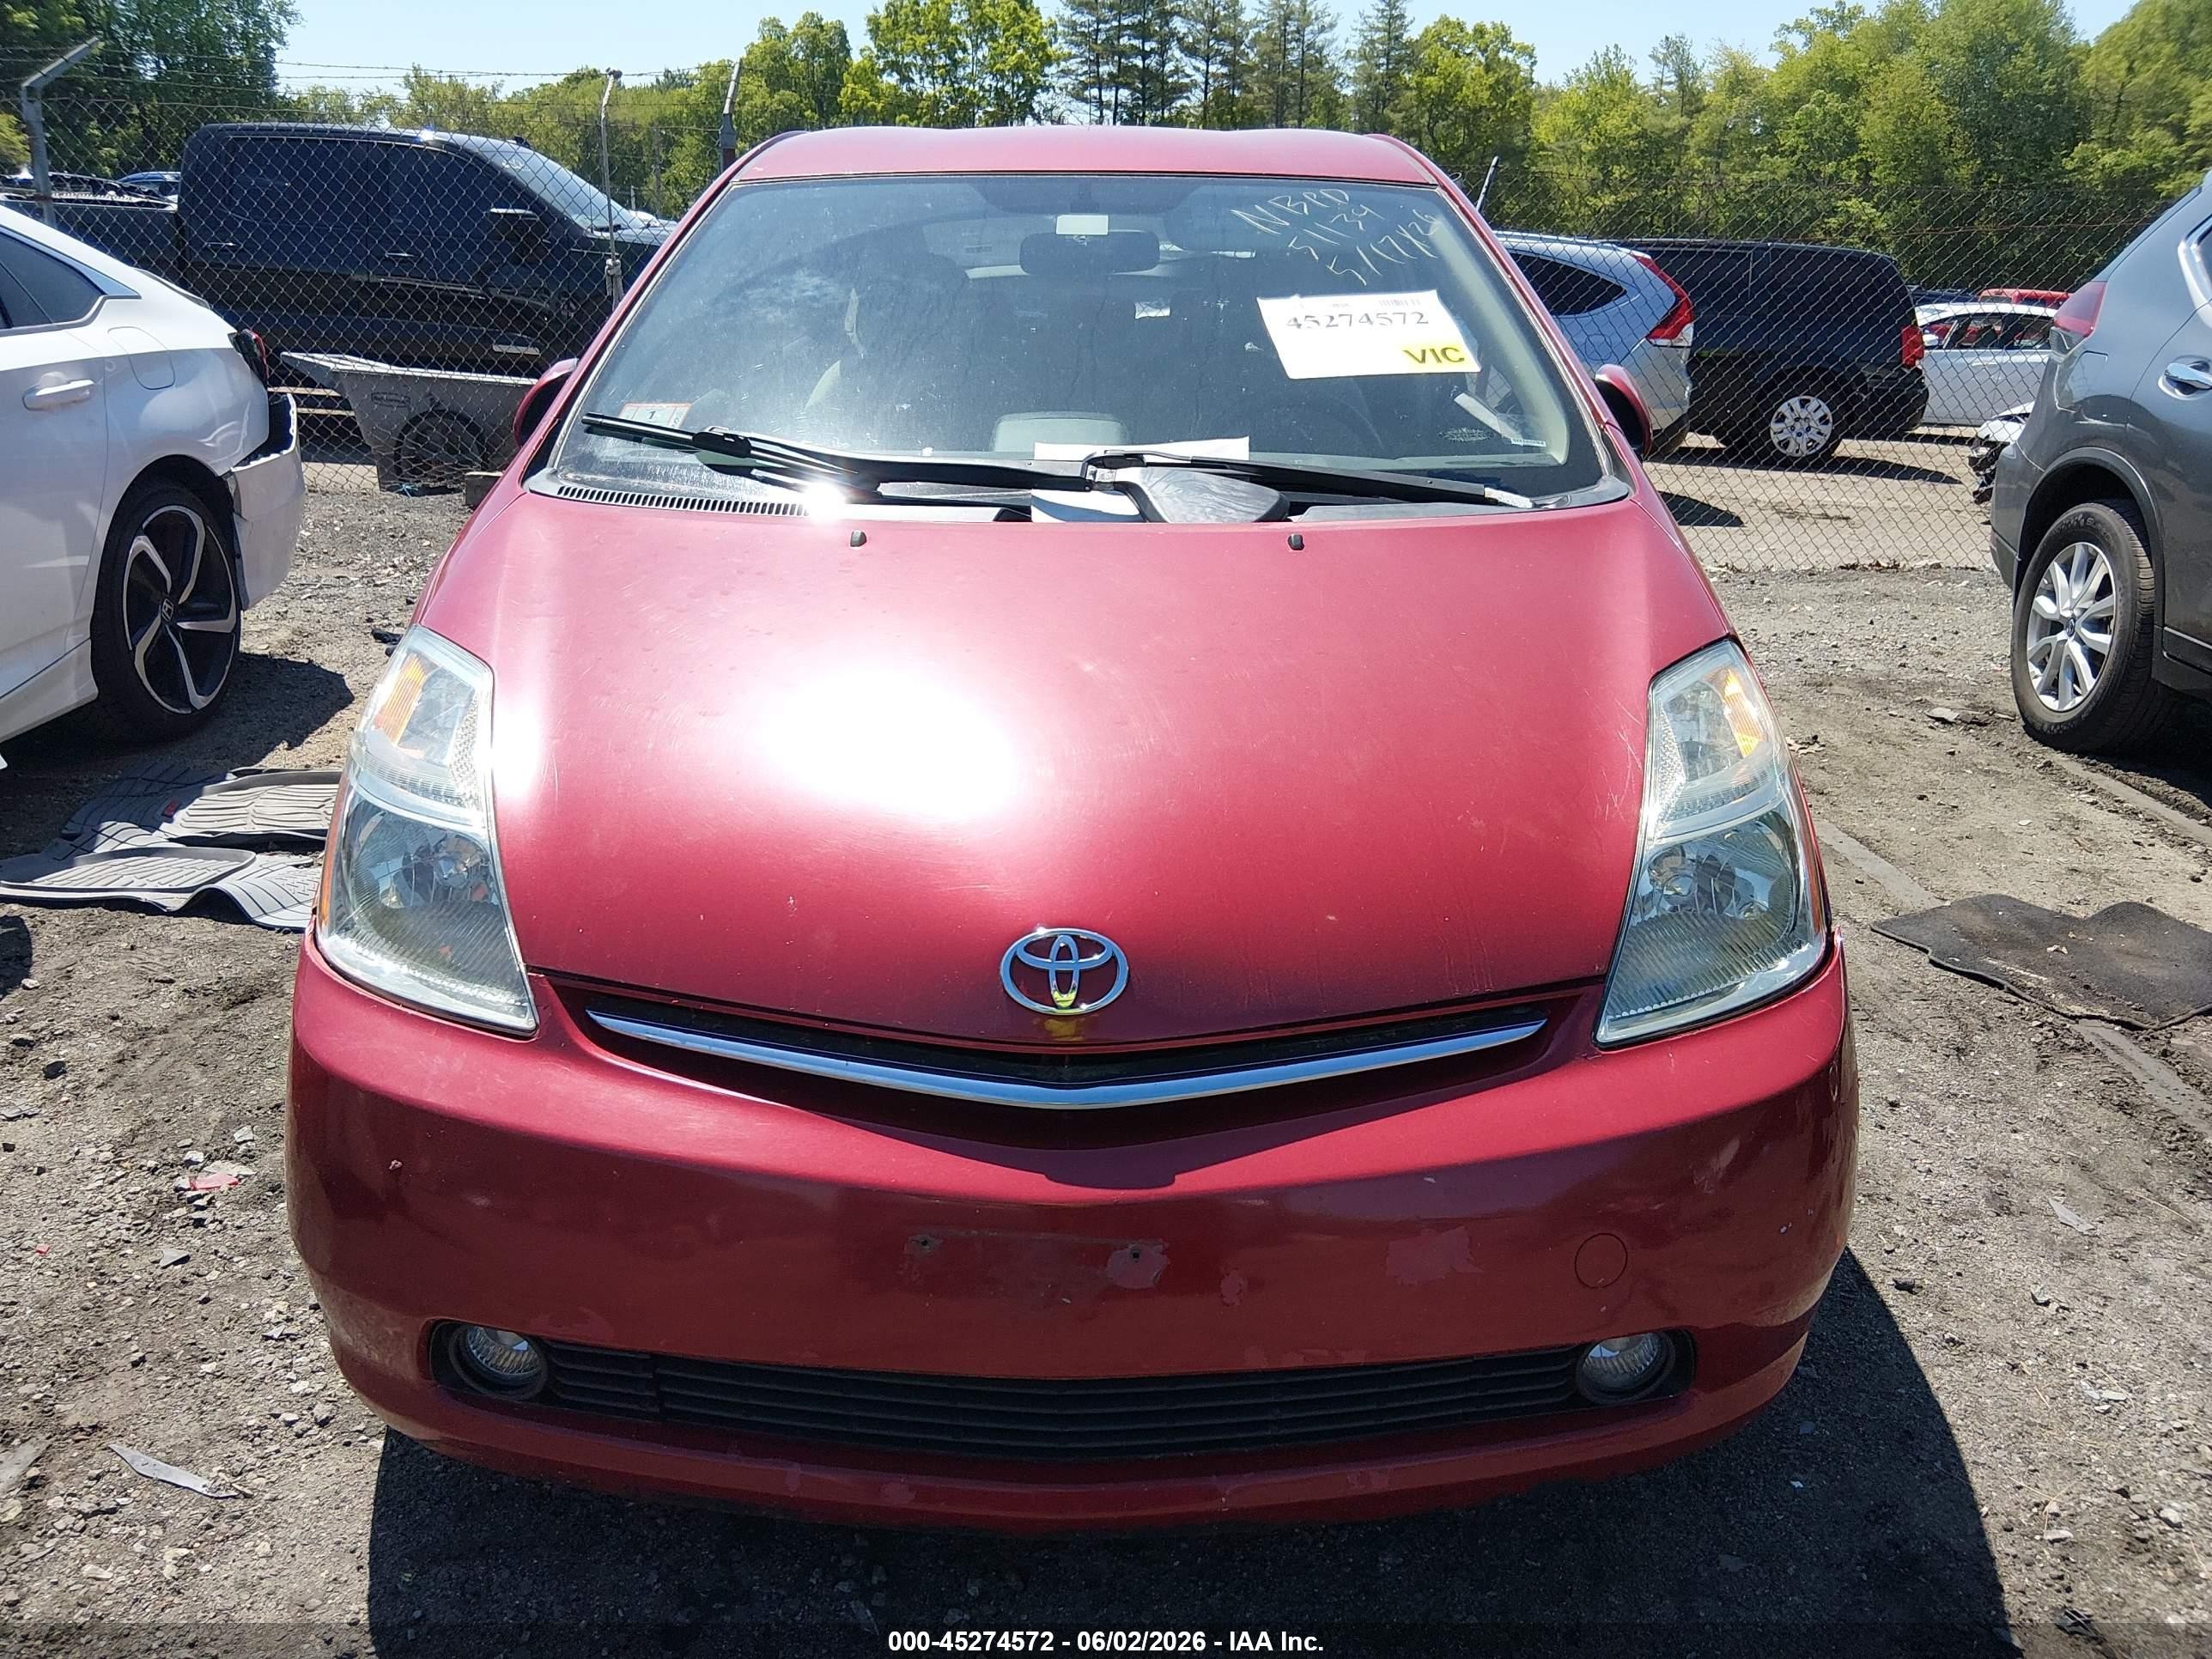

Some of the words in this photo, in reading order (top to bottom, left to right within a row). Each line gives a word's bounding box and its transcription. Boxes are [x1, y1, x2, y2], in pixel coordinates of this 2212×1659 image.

[1230, 189, 1350, 235] NBPD
[1286, 311, 1430, 330] 45274572
[1402, 347, 1465, 364] VIC
